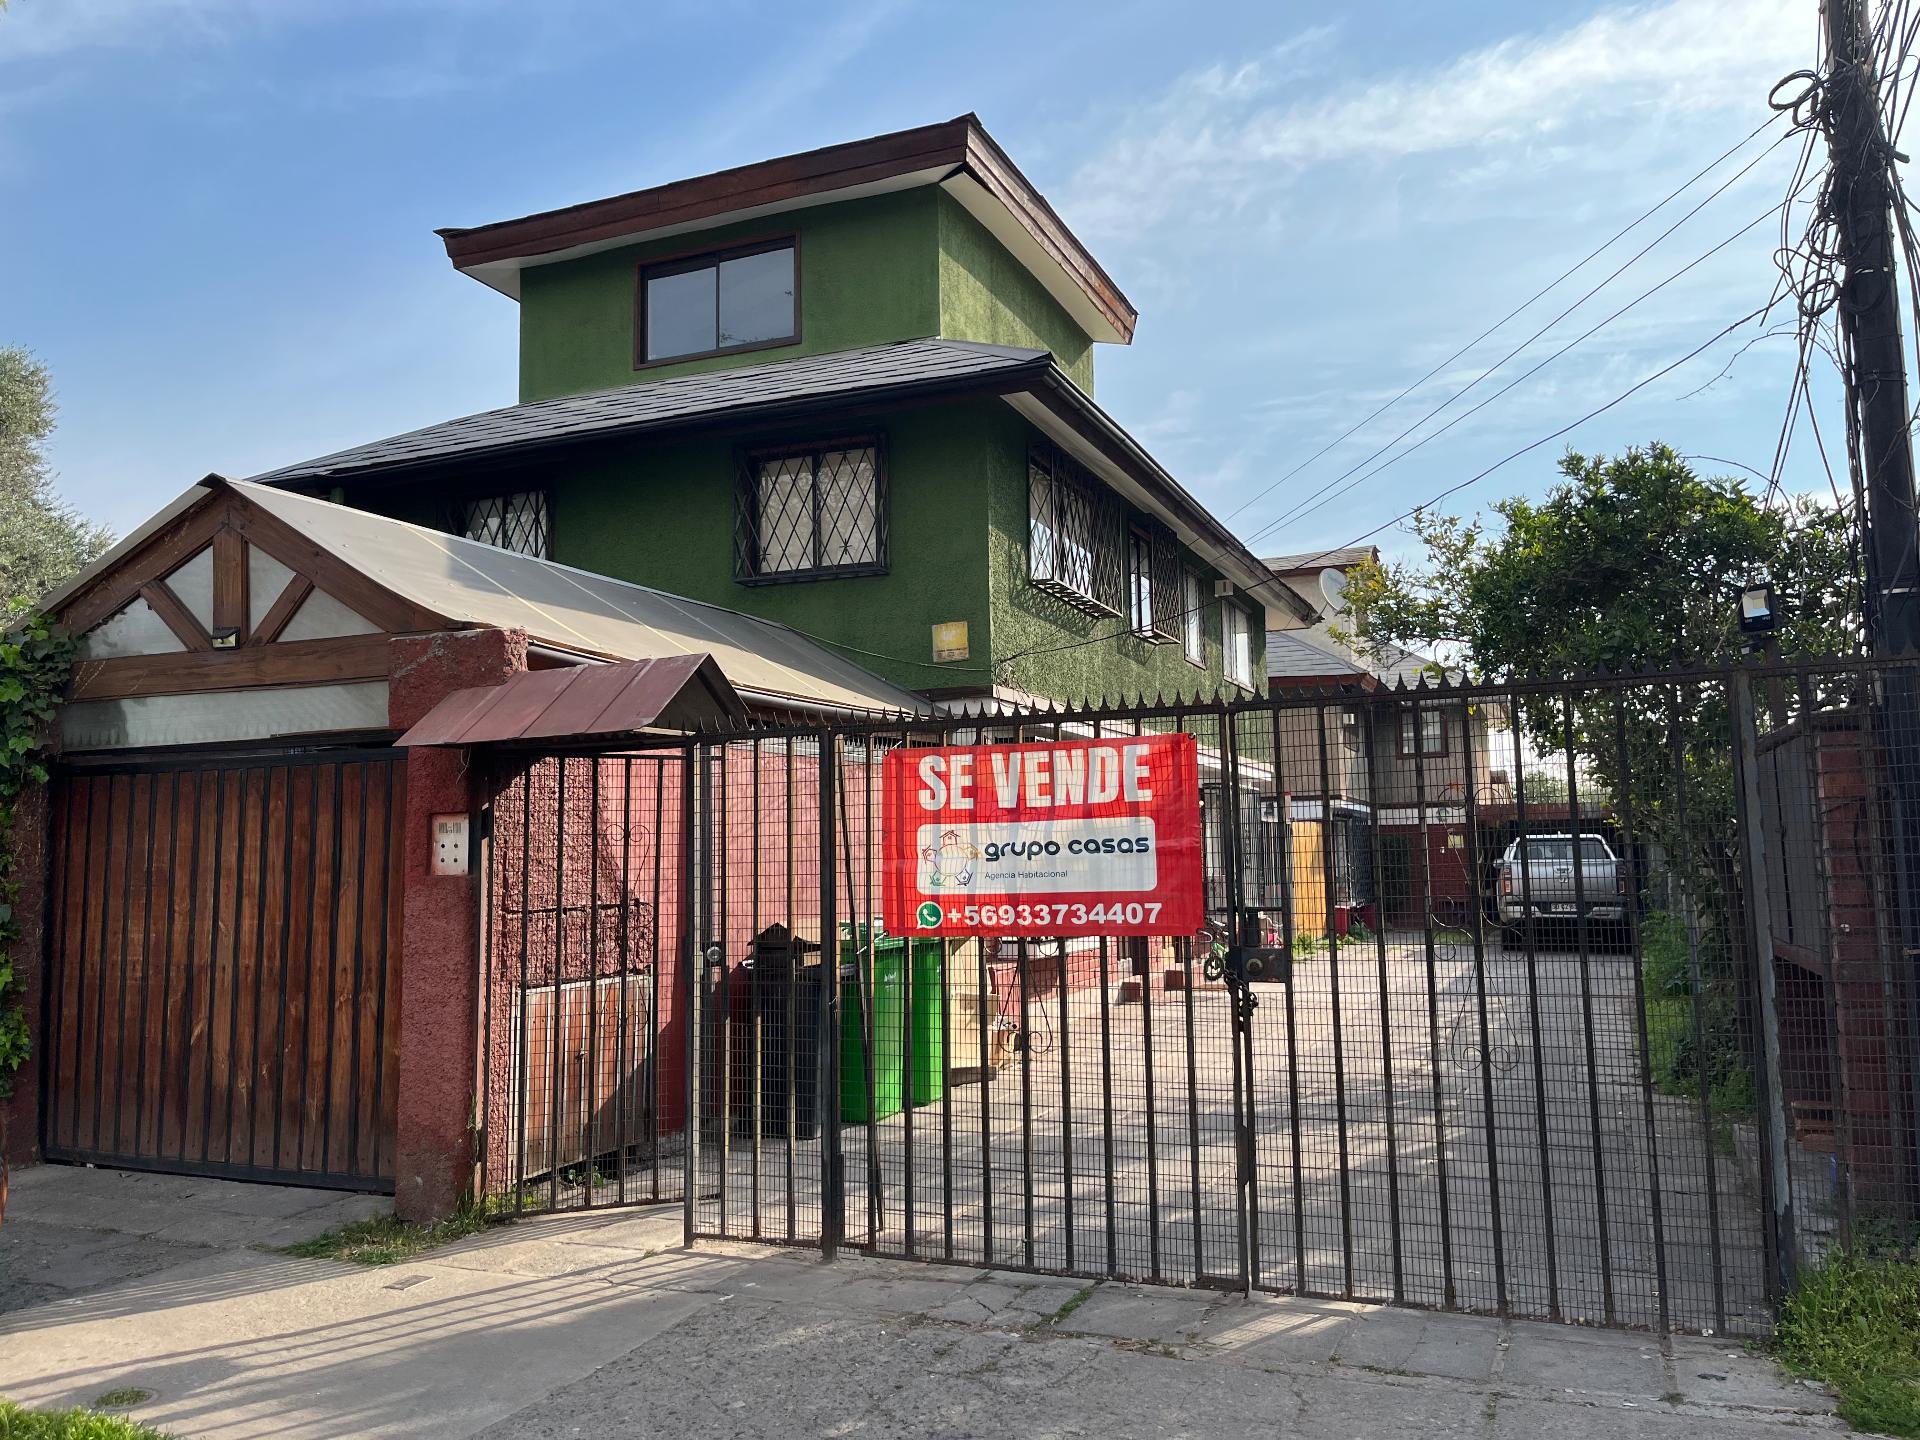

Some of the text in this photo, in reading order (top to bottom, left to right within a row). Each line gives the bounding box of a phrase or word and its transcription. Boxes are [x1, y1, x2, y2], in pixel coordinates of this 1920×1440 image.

[918, 743, 1153, 810] SE VENDE
[984, 836, 1150, 862] grupo casas
[984, 869, 1068, 881] Agencia Habitacional
[947, 902, 1162, 926] +56933734407
